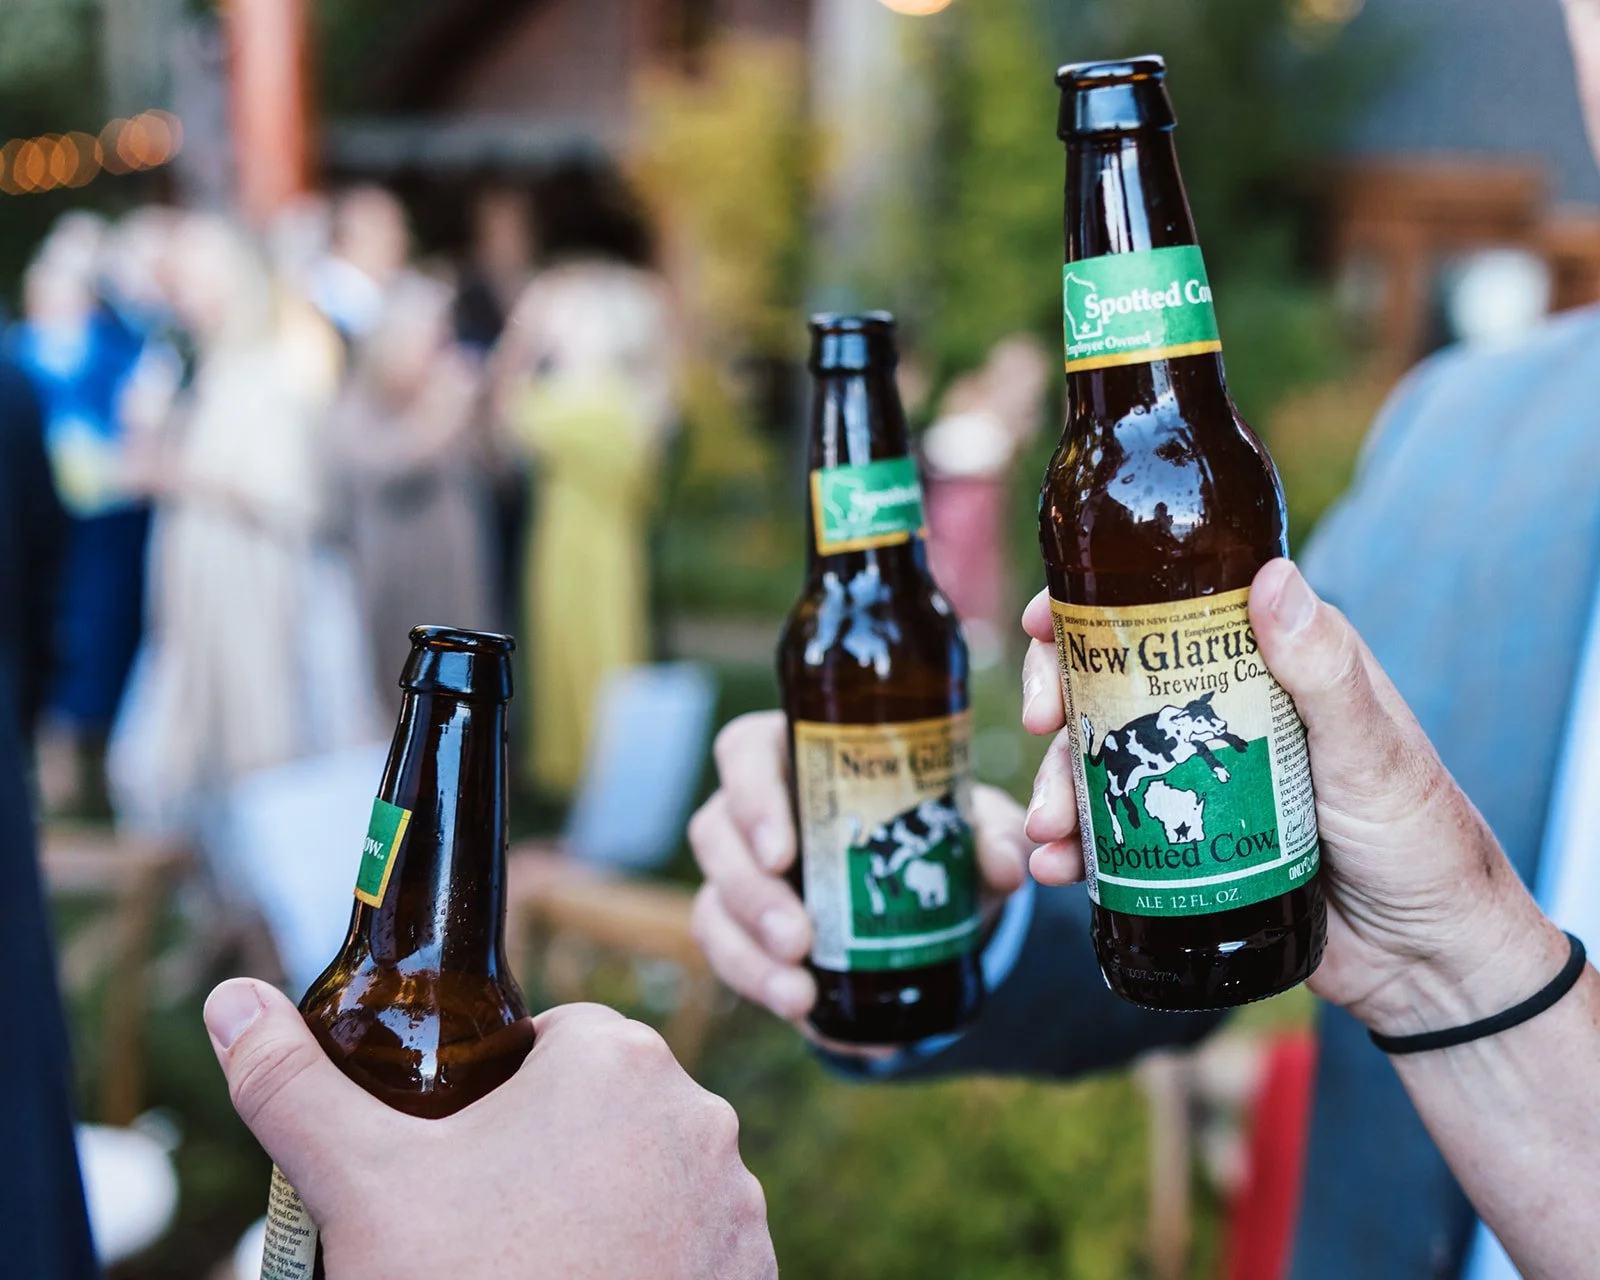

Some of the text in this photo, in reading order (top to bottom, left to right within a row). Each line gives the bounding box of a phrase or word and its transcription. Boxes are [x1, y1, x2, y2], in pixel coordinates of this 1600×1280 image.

[1084, 281, 1184, 324] Spotted
[1105, 331, 1152, 349] Owned
[1096, 619, 1133, 628] BOTTLED
[1134, 619, 1145, 627] IN
[1146, 616, 1168, 626] NEW
[1184, 624, 1225, 638] Employee
[1067, 627, 1258, 674] New Glarus
[1146, 668, 1229, 697] Brewing
[1097, 835, 1202, 874] Spotted
[1210, 828, 1276, 863] Cow
[1289, 861, 1305, 880] ONLY
[1135, 887, 1242, 909] ALE 12 FL. OZ.
